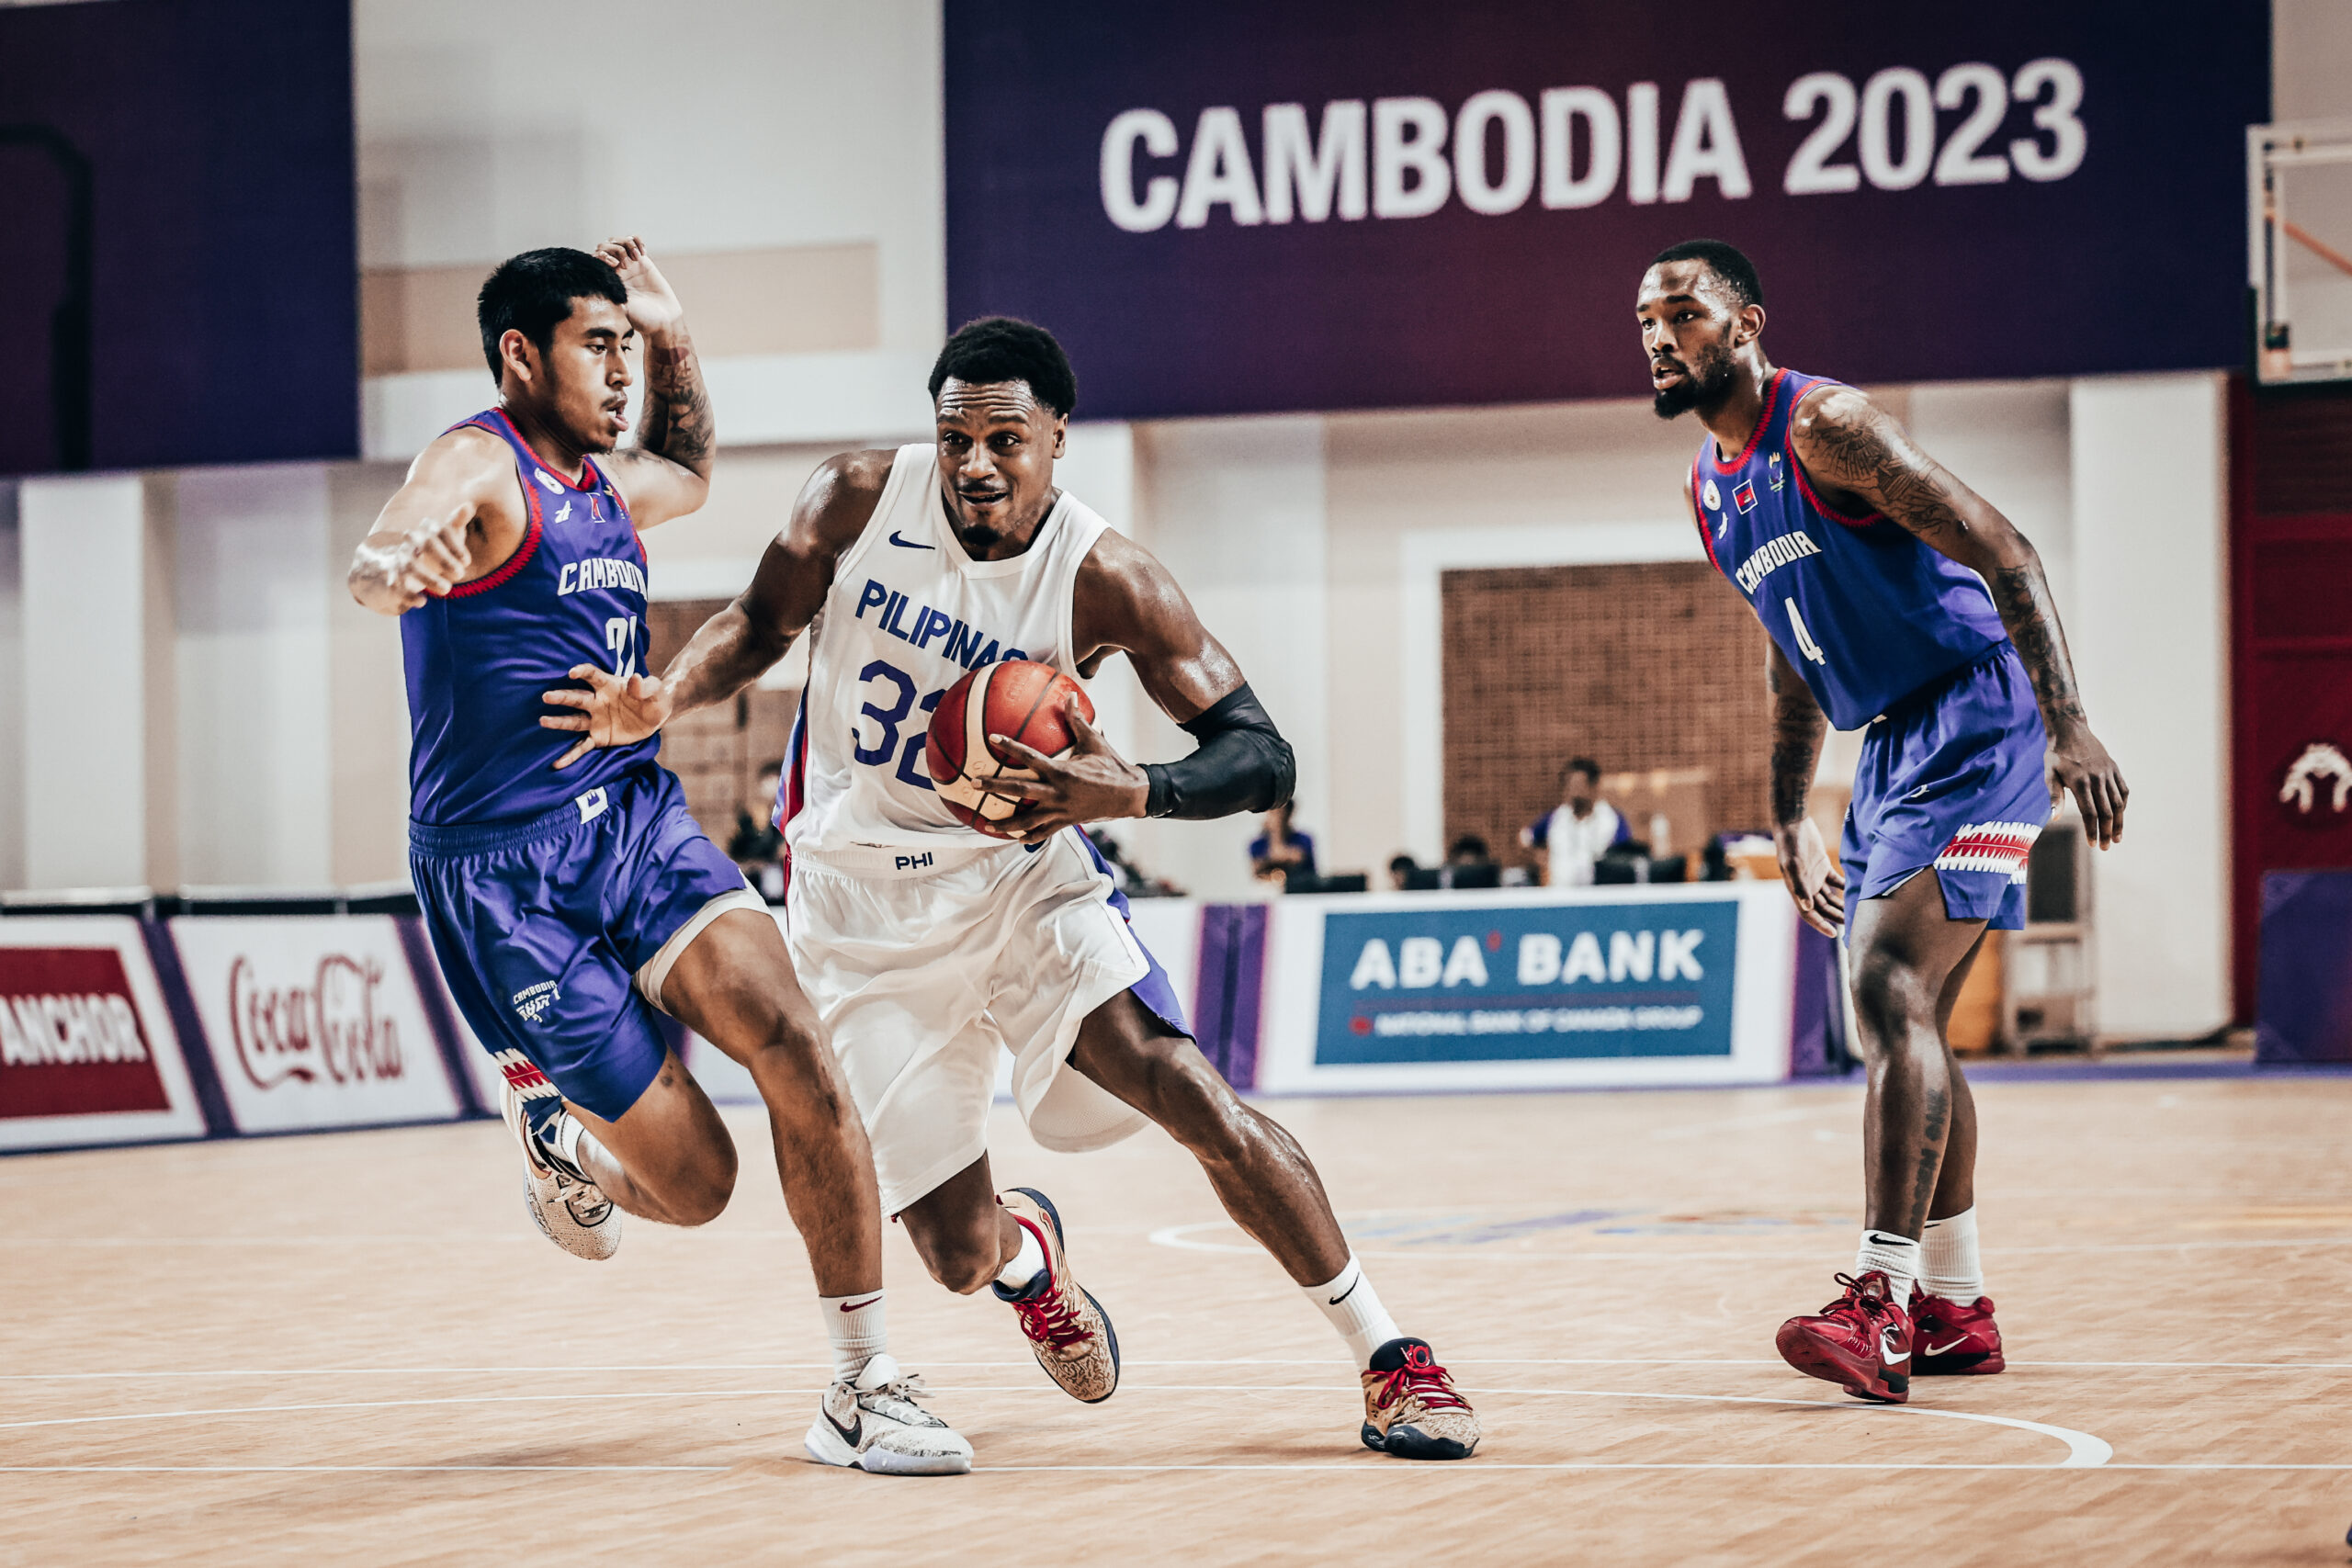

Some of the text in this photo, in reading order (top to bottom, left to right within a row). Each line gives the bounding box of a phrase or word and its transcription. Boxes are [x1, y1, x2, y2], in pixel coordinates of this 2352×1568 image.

[1101, 58, 2086, 232] CAMBODIA 2023
[1736, 530, 1822, 595] CAMBODIA
[855, 579, 1028, 671] PILIPINA
[1784, 596, 1826, 666] 4
[895, 852, 933, 870] PHI
[513, 979, 558, 1005] CAMBODIA
[1350, 929, 1704, 989] ABA BANK
[0, 993, 147, 1066] ANCHOR
